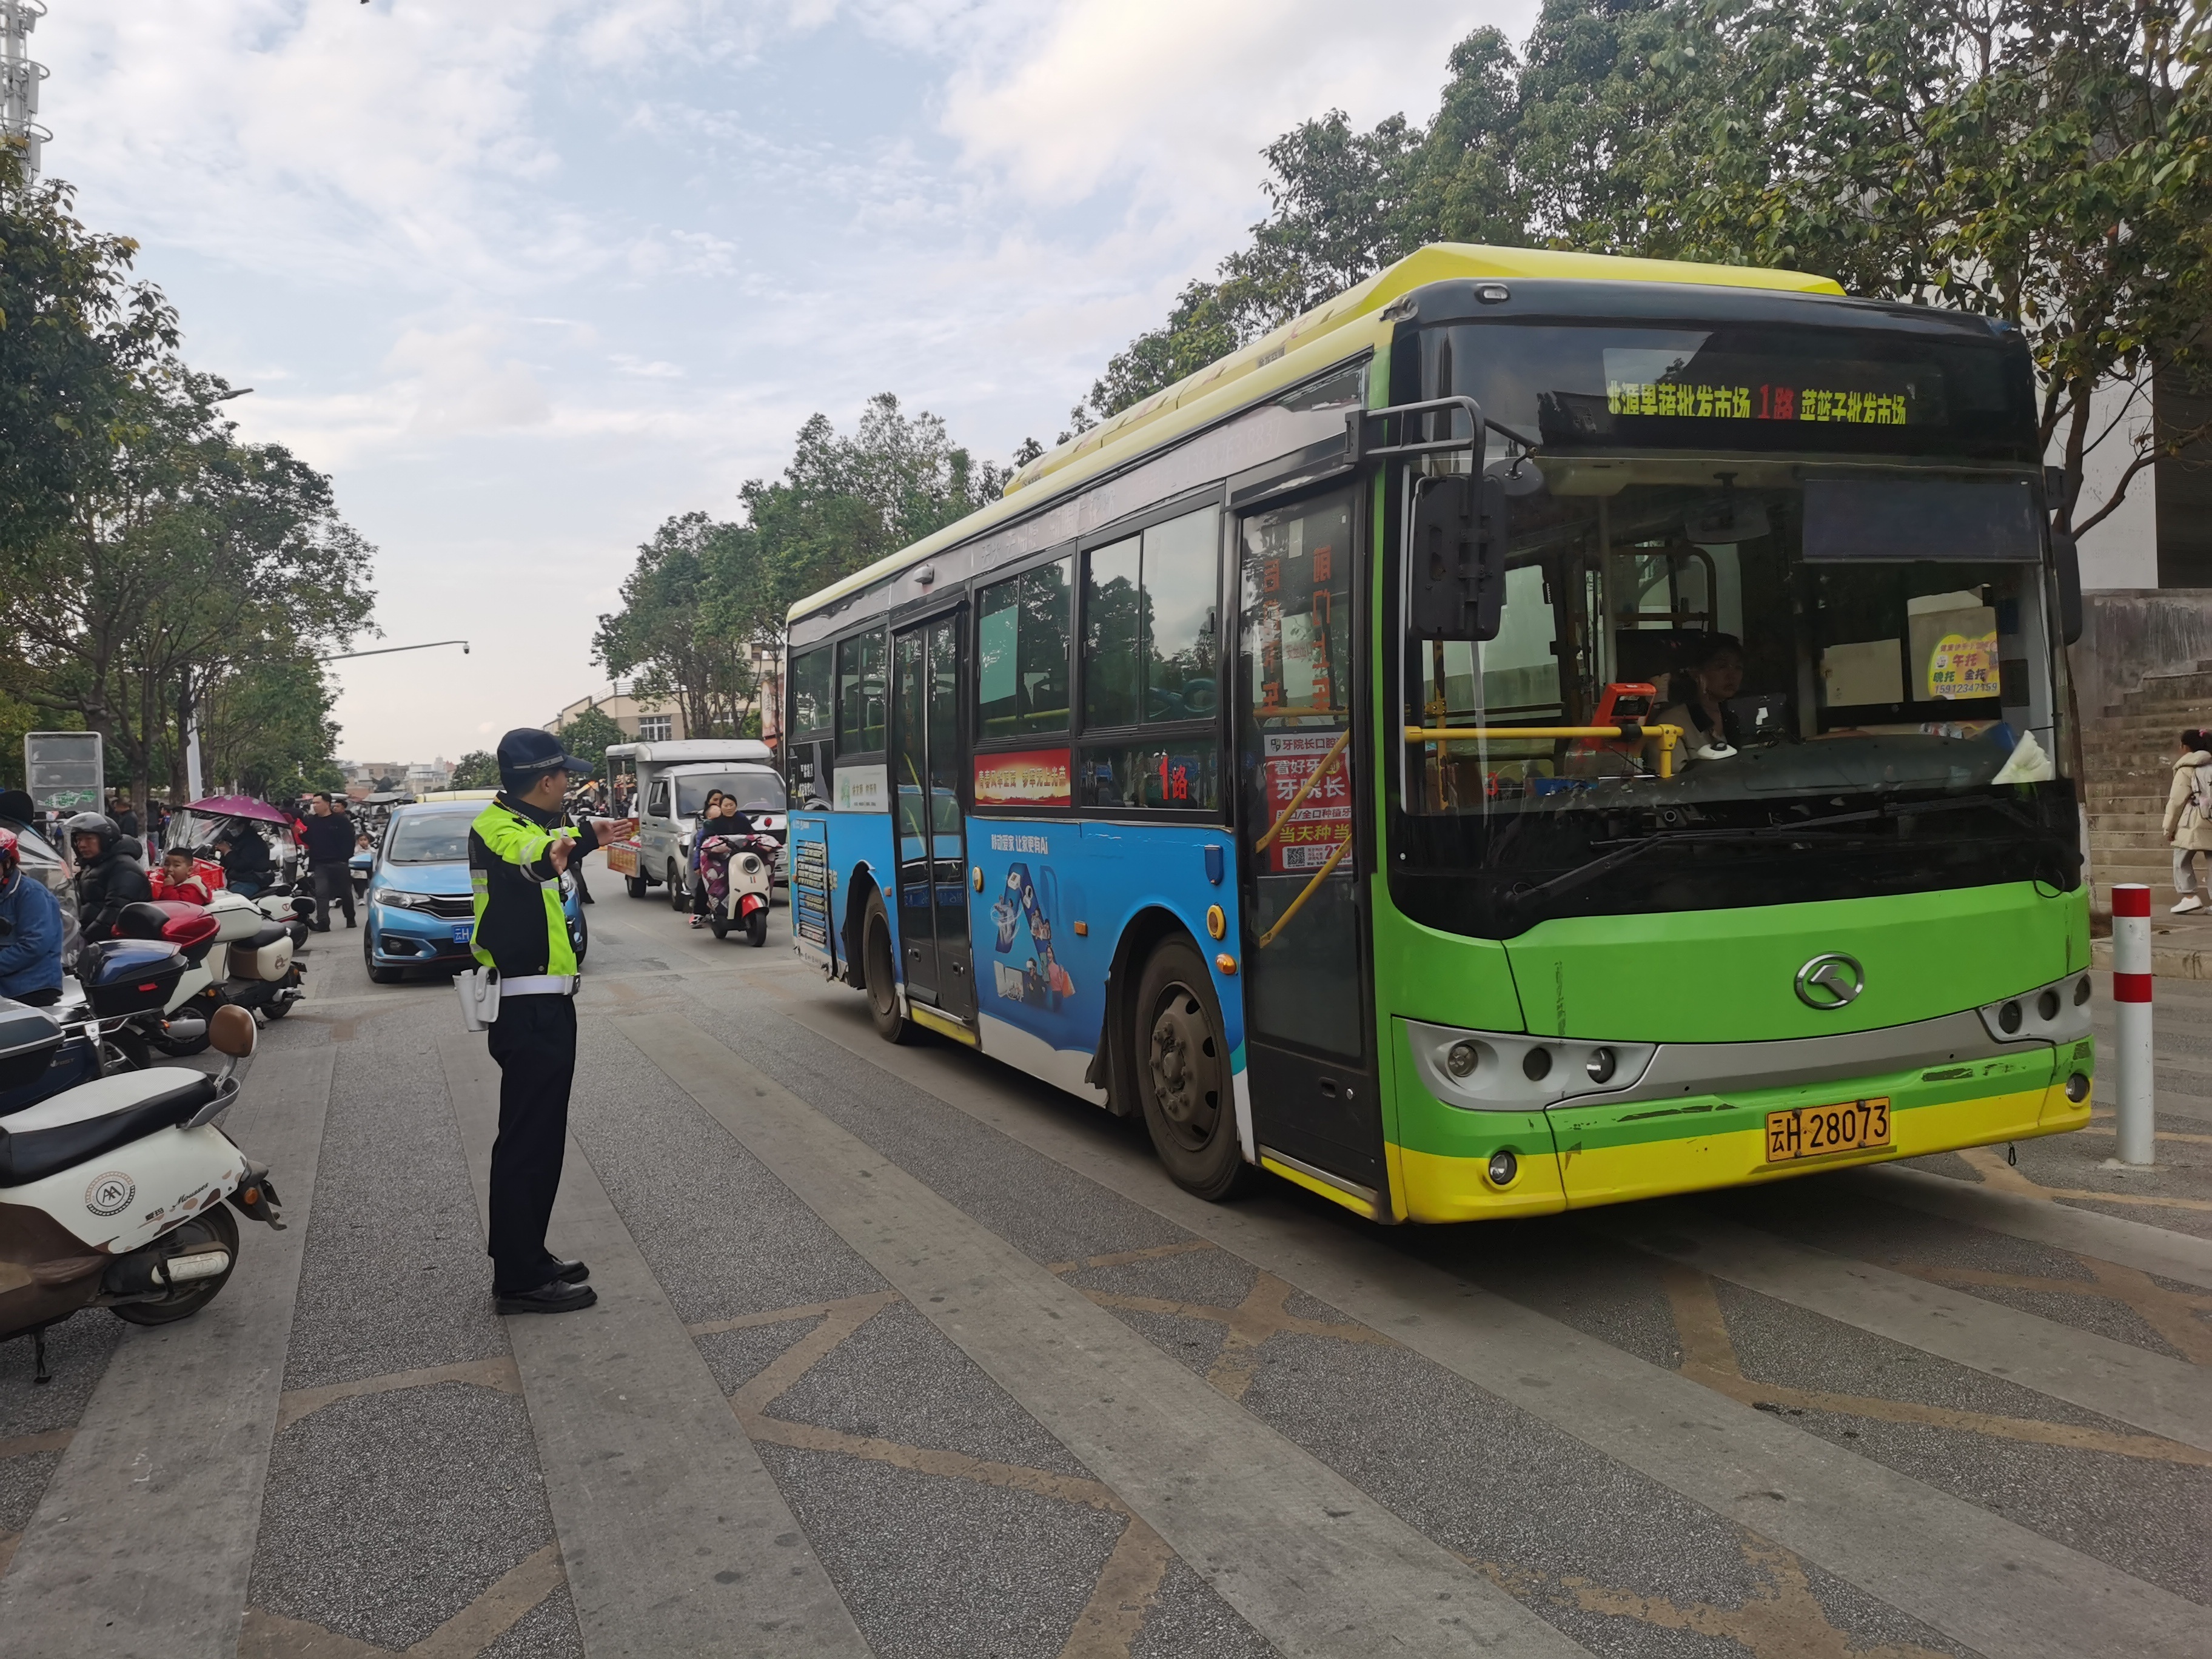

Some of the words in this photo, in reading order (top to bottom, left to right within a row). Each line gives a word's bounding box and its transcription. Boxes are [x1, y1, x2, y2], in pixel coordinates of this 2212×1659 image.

[1758, 384, 1794, 420] 1路
[1800, 389, 1906, 424] 菜篮子批发市场
[1952, 654, 1977, 668] 午托
[1282, 737, 1341, 750] 牙院长口腔
[1159, 752, 1188, 800] 1路
[172, 1182, 209, 1208] Mousses
